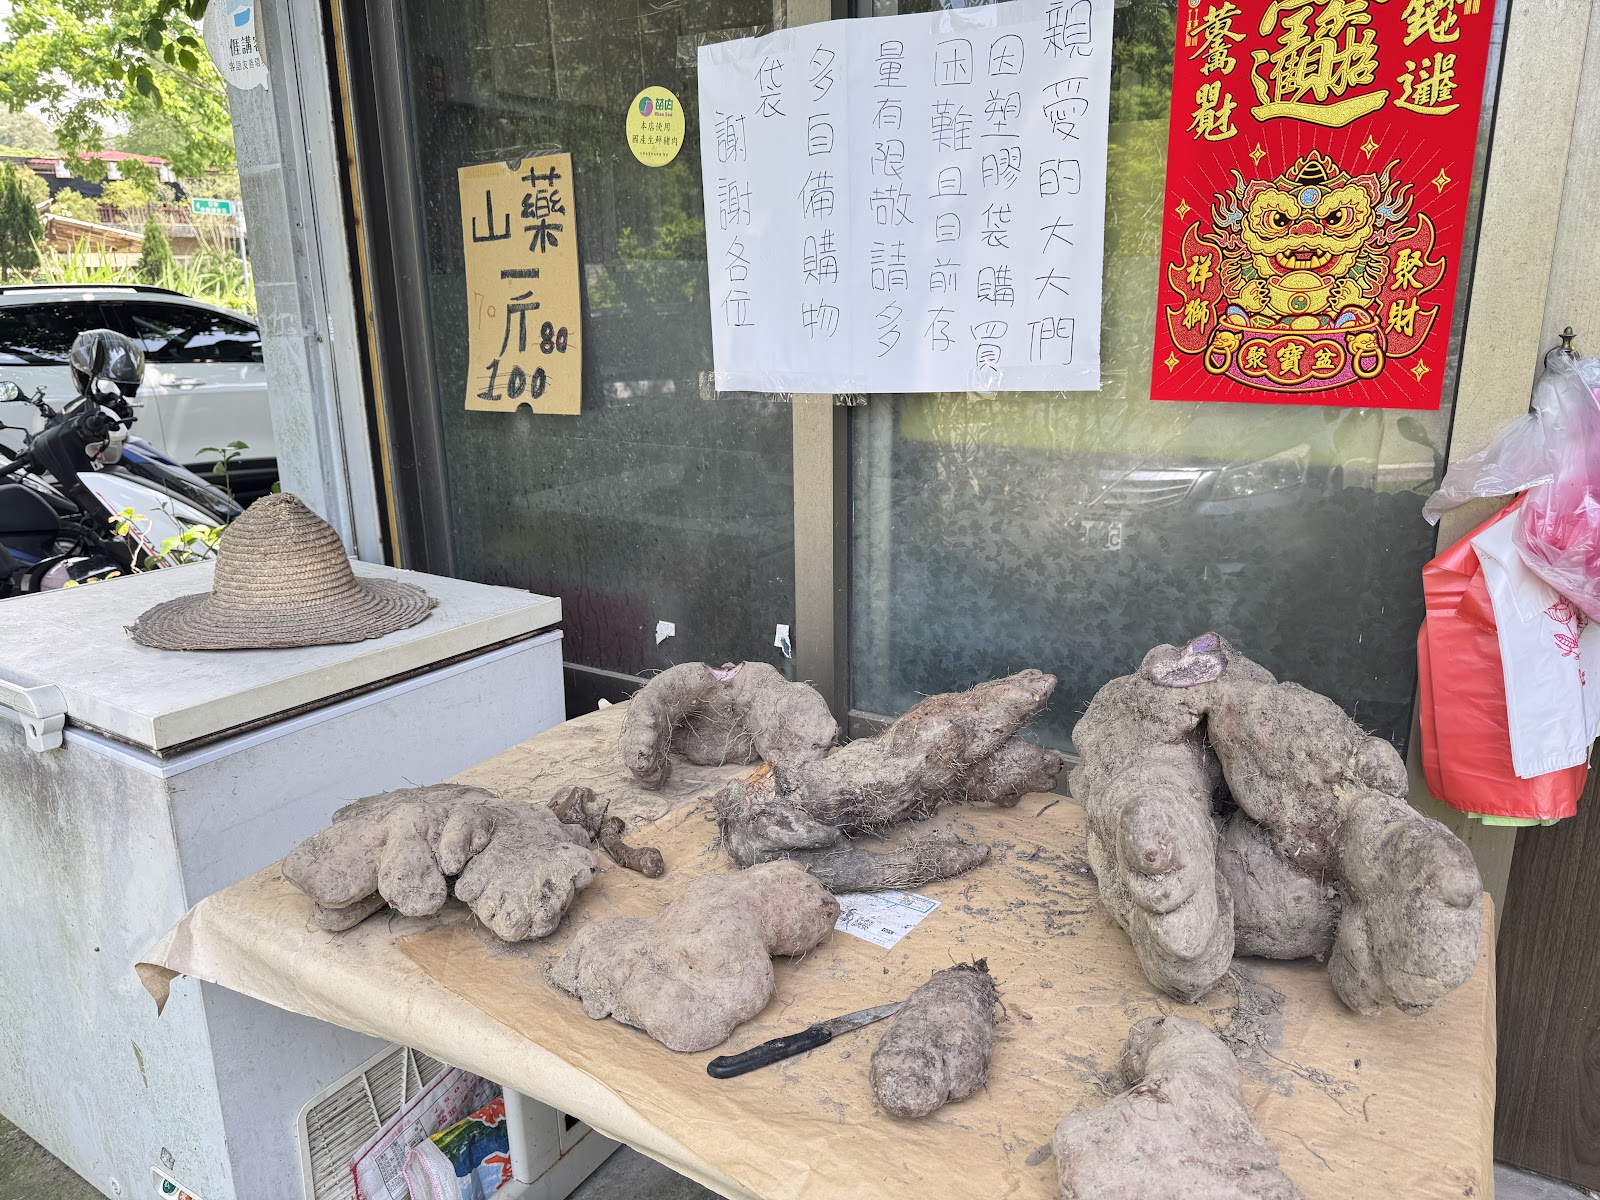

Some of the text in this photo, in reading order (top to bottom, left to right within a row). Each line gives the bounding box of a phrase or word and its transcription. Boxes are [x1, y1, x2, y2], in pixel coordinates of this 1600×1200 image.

[754, 56, 786, 119] 袋
[715, 110, 755, 327] 謝謝各位
[798, 43, 840, 340] 多自備購物
[970, 34, 1025, 372] 因塑膠袋購買
[1028, 1, 1093, 366] 親愛的大大們
[499, 267, 541, 358] 一斤
[1183, 253, 1214, 335] 祥獅
[1385, 248, 1425, 337] 聚財
[476, 358, 548, 401] 100
[539, 320, 568, 355] 80
[1244, 341, 1337, 376] 聚寶盆
